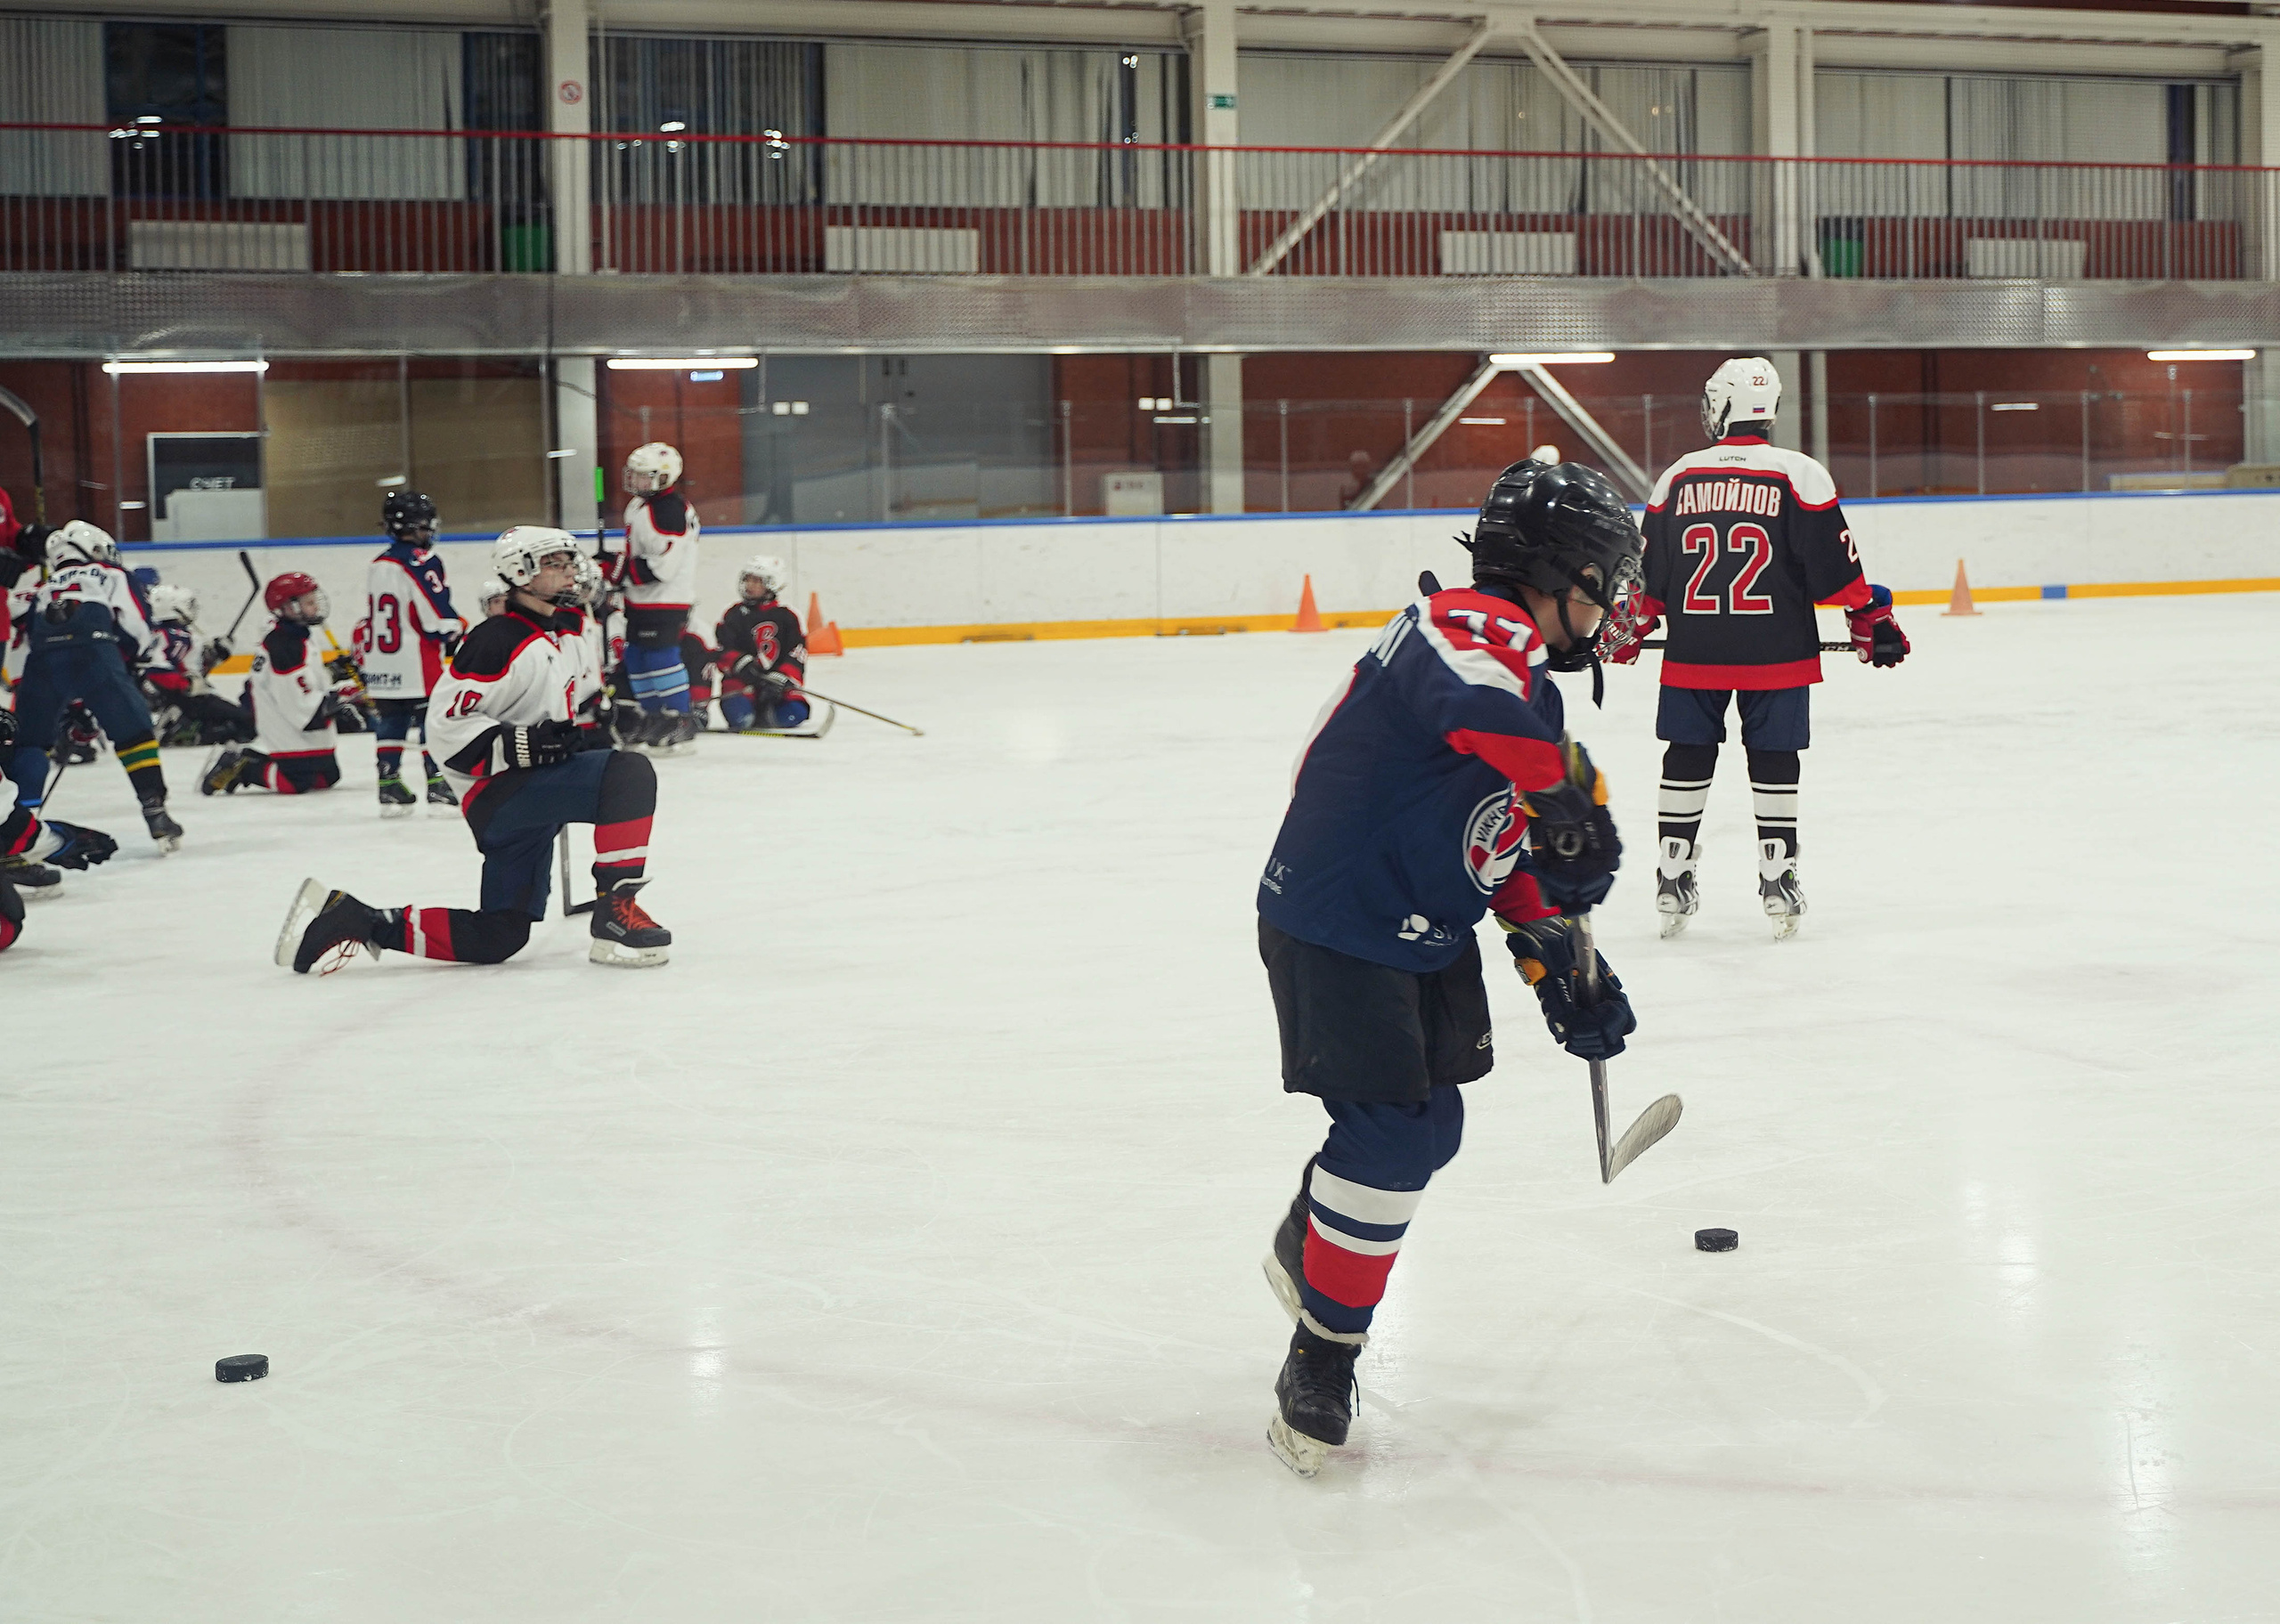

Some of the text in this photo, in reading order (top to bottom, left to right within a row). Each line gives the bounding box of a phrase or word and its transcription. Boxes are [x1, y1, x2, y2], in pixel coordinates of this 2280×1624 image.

[1752, 376, 1766, 386] 22
[1682, 521, 1774, 616] 22
[1447, 608, 1534, 654] 77
